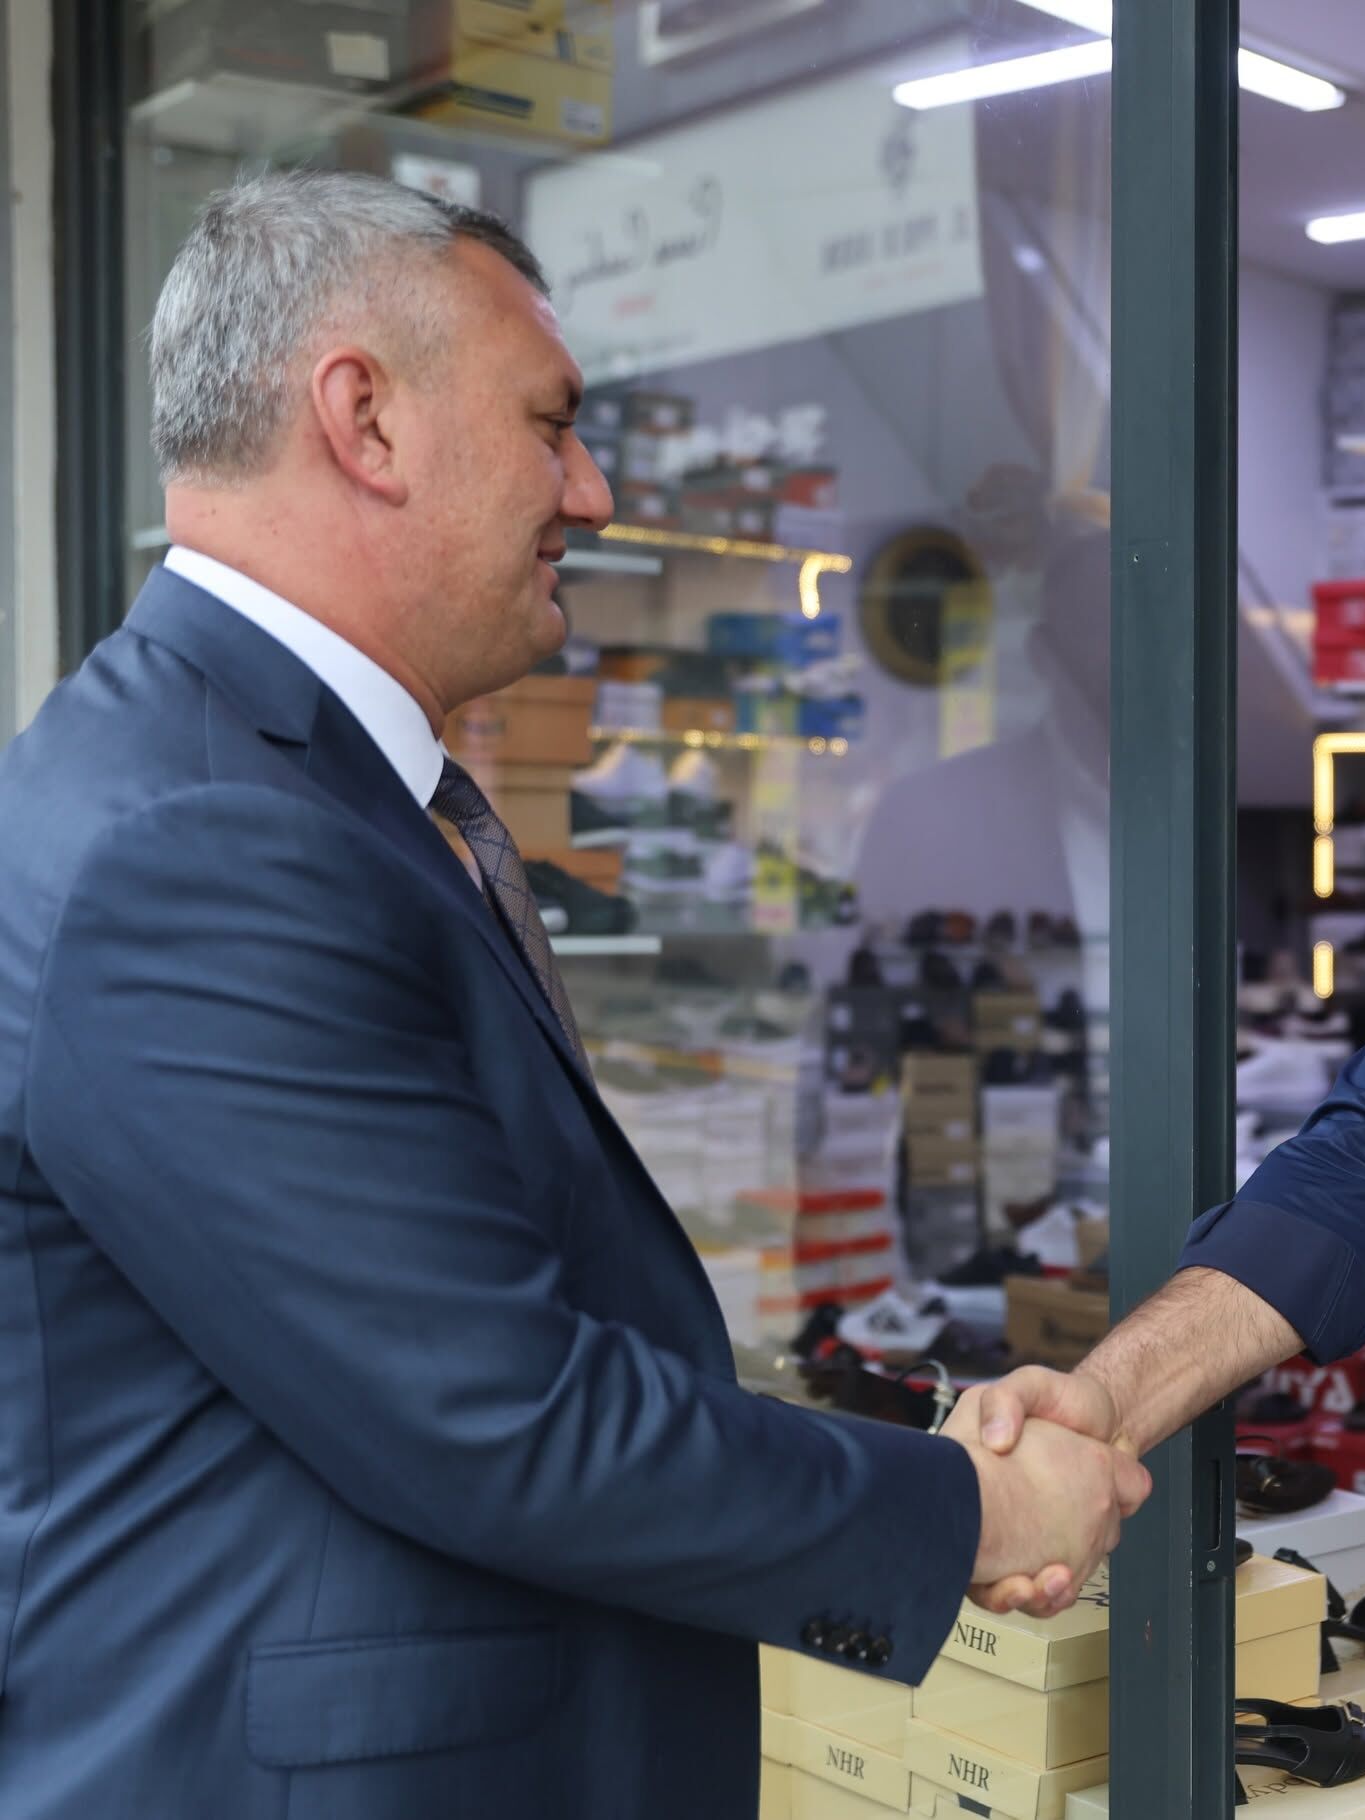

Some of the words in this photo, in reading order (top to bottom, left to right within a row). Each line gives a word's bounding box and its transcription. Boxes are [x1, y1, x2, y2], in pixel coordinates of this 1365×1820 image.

[954, 1620, 997, 1656] NHR
[826, 1744, 865, 1780] NHR
[948, 1753, 990, 1791] NHR
